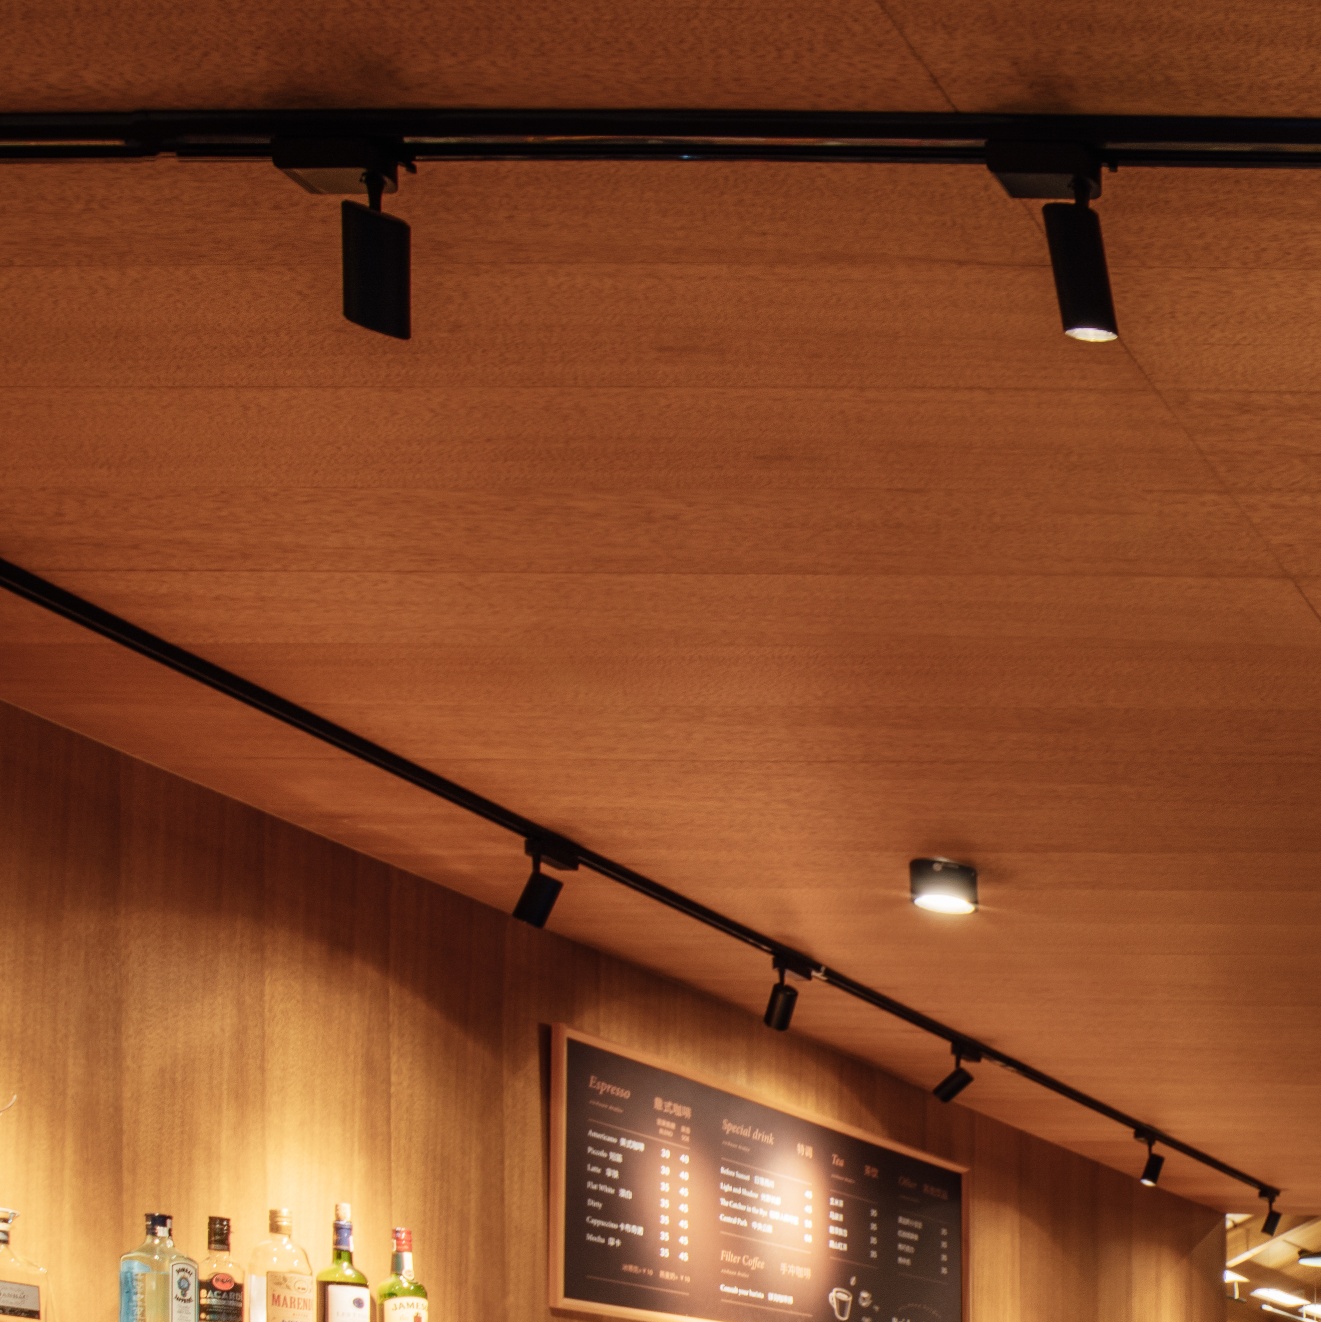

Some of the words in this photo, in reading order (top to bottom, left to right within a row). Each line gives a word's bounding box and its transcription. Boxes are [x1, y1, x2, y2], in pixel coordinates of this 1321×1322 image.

[589, 1075, 631, 1099] Espresso
[722, 1119, 752, 1138] Special
[752, 1128, 775, 1146] drink
[831, 1153, 845, 1168] Tea
[721, 1249, 741, 1264] Filter
[742, 1254, 765, 1270] Coffee
